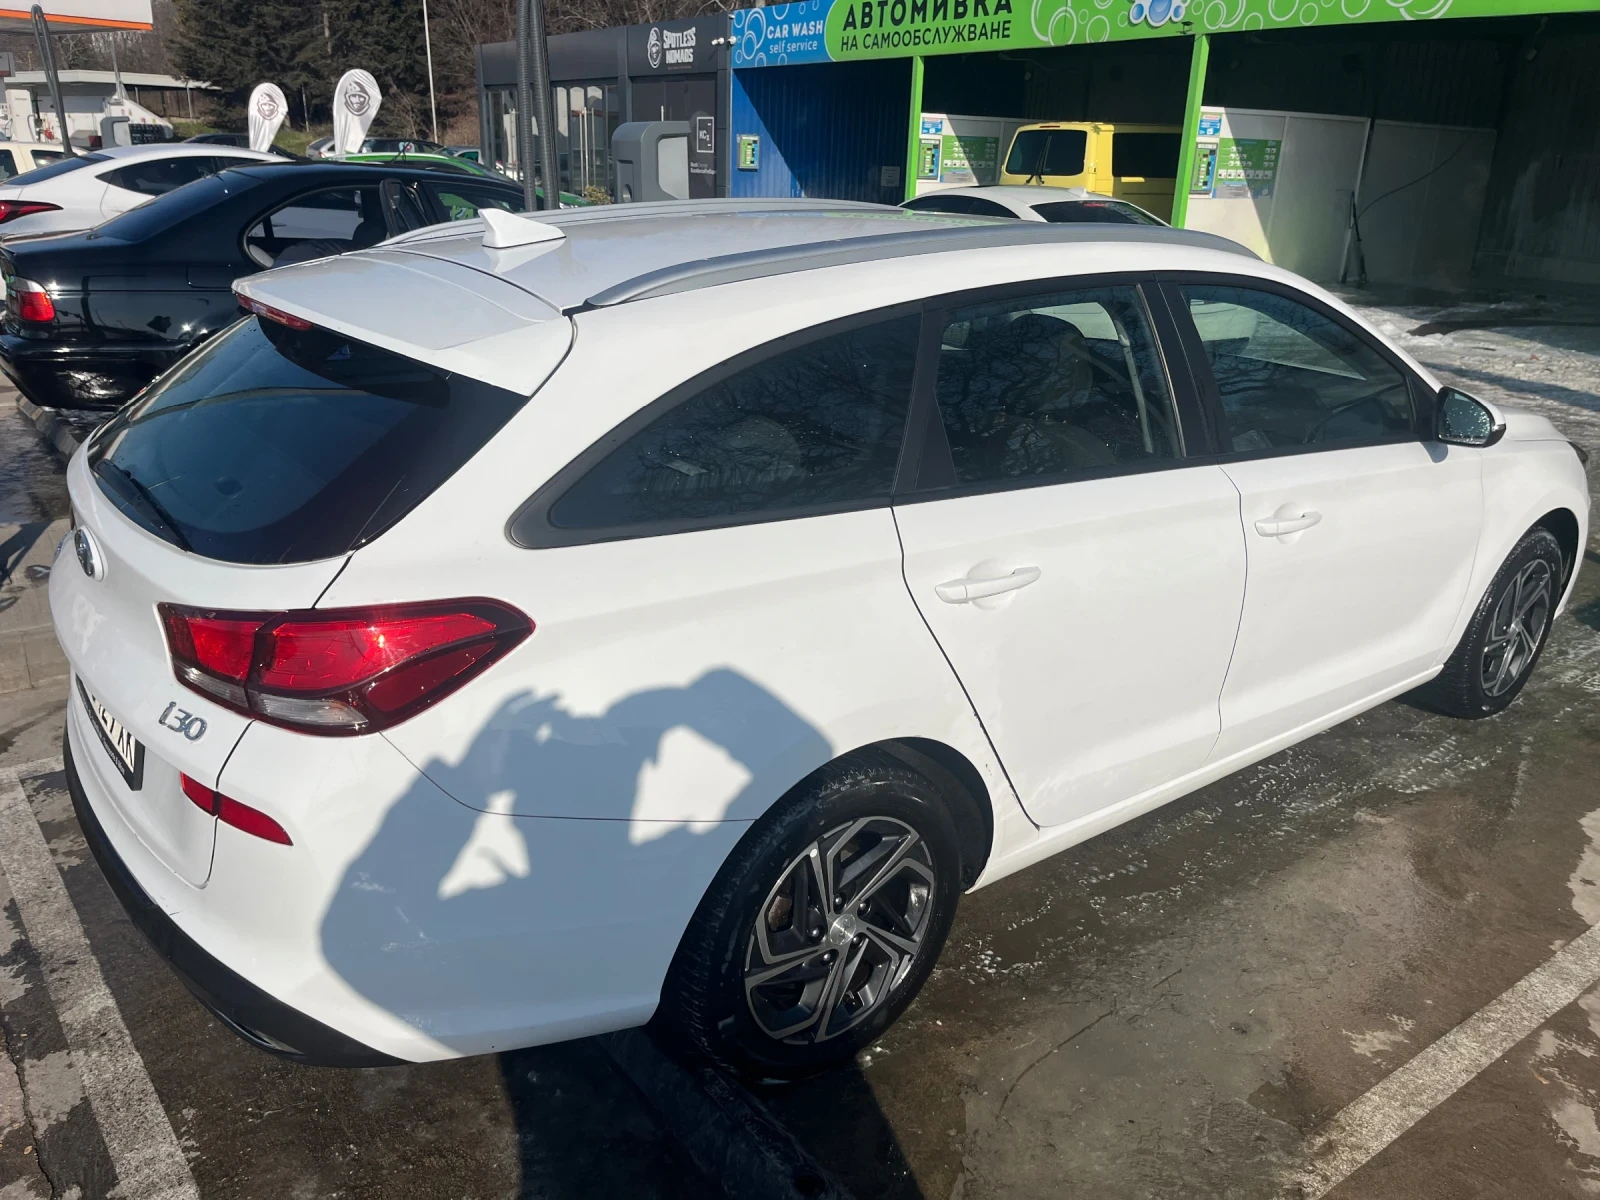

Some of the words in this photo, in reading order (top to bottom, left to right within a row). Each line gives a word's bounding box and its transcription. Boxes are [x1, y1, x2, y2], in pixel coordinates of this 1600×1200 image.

[663, 26, 696, 49] SPOTLESS
[767, 24, 789, 39] CAR
[792, 20, 824, 37] WASH
[841, 35, 858, 52] НА
[863, 20, 1012, 49] САМООБСЛУЖВАНЕ
[666, 48, 694, 64] NOMADS
[769, 40, 786, 54] self
[787, 39, 818, 53] service
[158, 700, 208, 741] i30
